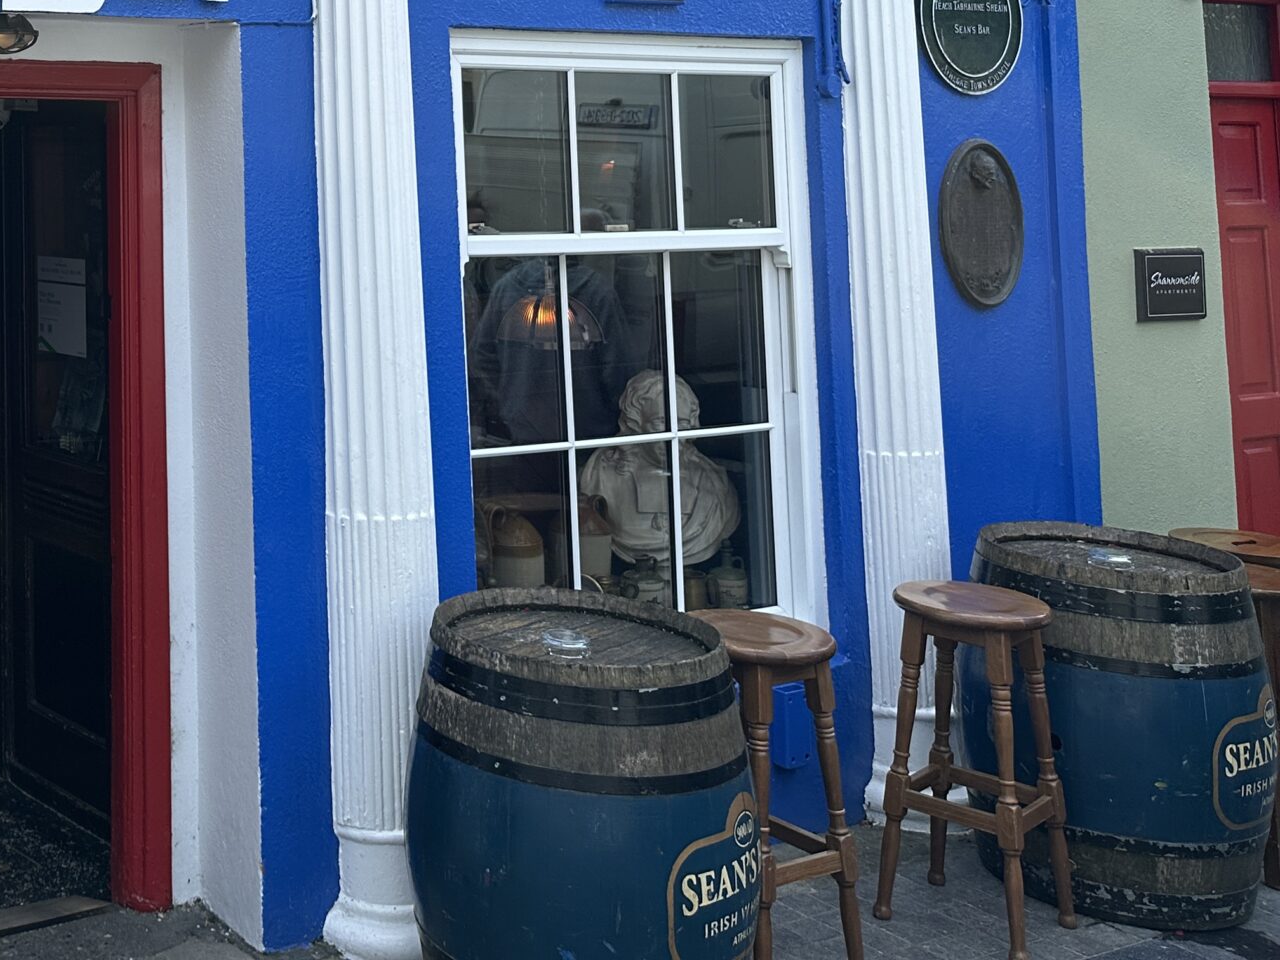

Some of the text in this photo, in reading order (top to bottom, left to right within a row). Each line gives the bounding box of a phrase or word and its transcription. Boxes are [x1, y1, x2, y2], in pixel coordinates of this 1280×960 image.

[1241, 778, 1268, 798] IRISH
[681, 850, 758, 917] SEAN'S
[704, 911, 738, 939] IRISH
